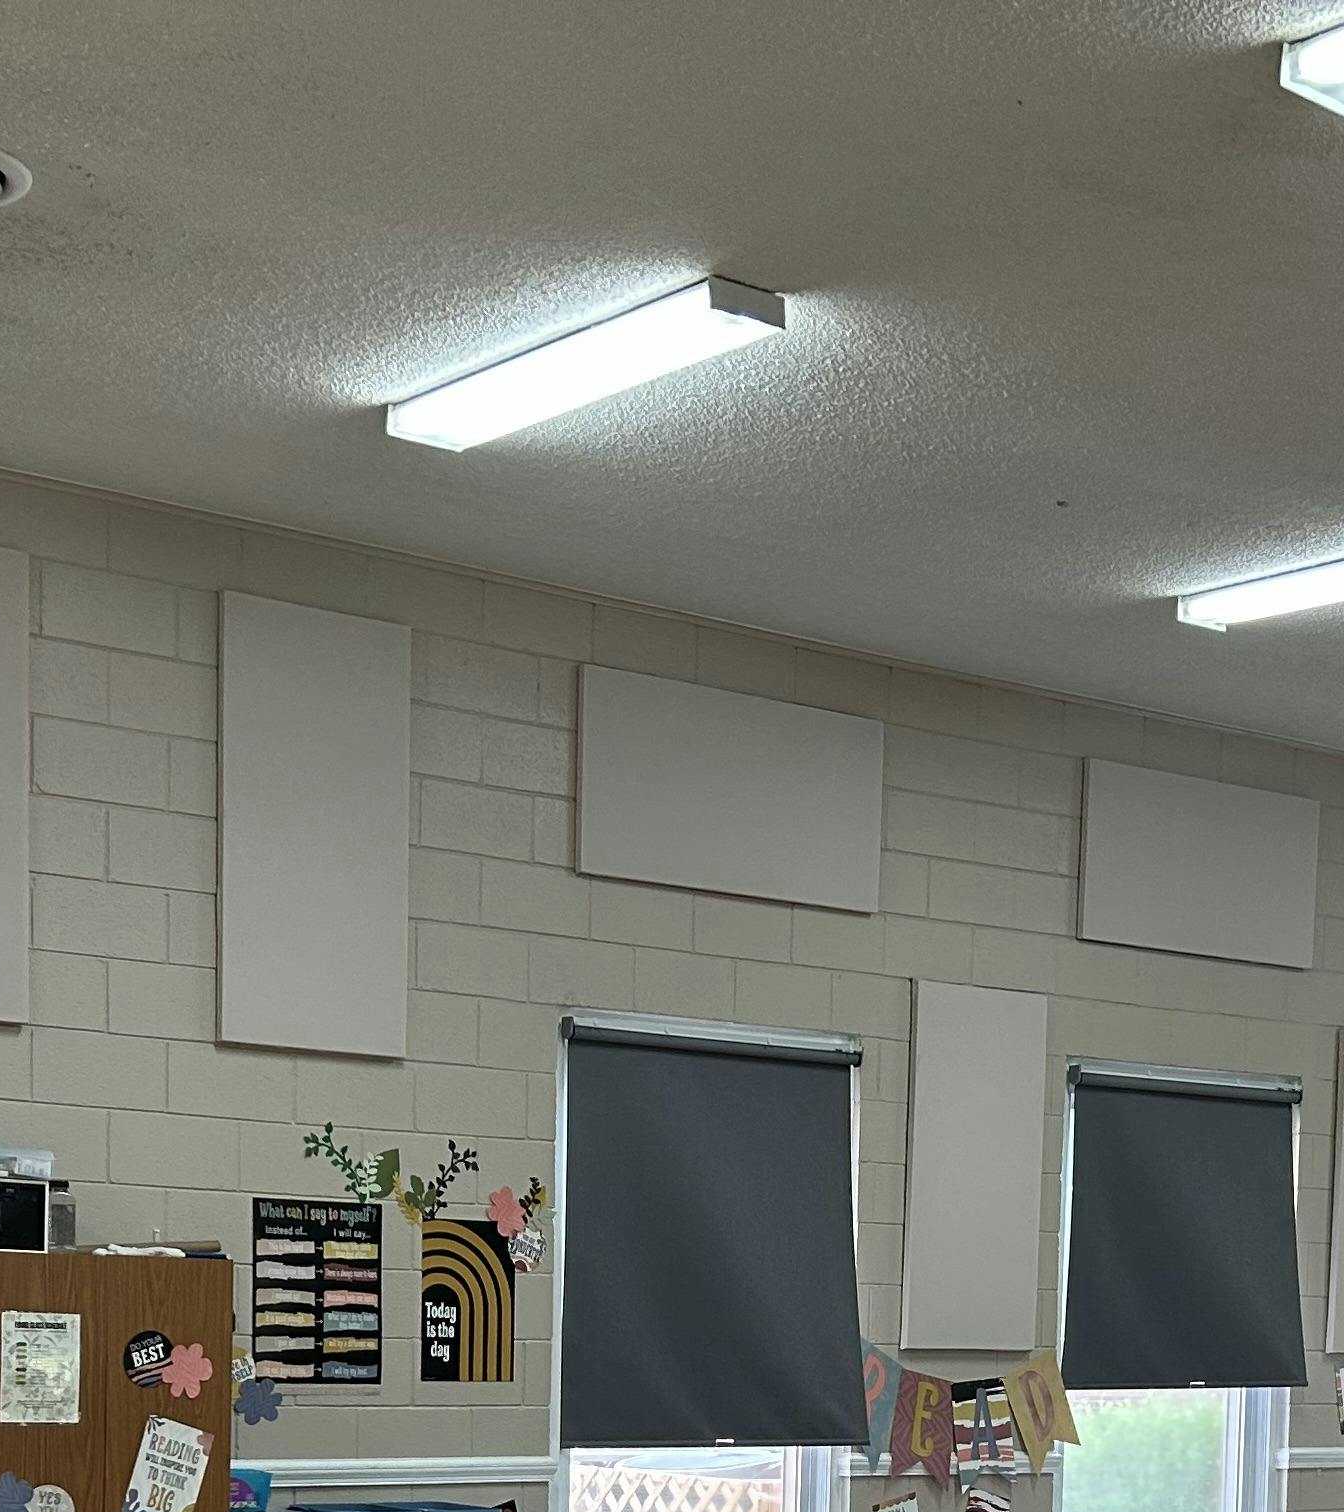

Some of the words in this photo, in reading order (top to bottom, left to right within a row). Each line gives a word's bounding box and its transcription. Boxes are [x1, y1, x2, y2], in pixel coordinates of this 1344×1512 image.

[258, 1201, 286, 1219] What
[286, 1206, 304, 1220] can
[310, 1207, 327, 1227] say
[328, 1206, 339, 1220] to
[424, 1301, 456, 1323] Today
[426, 1320, 437, 1338] is
[437, 1321, 455, 1338] the
[131, 1343, 164, 1367] BEST
[430, 1340, 450, 1362] day
[148, 1432, 201, 1464] READING
[147, 1465, 159, 1481] TO
[159, 1469, 188, 1490] THINK
[38, 1490, 63, 1505] YES
